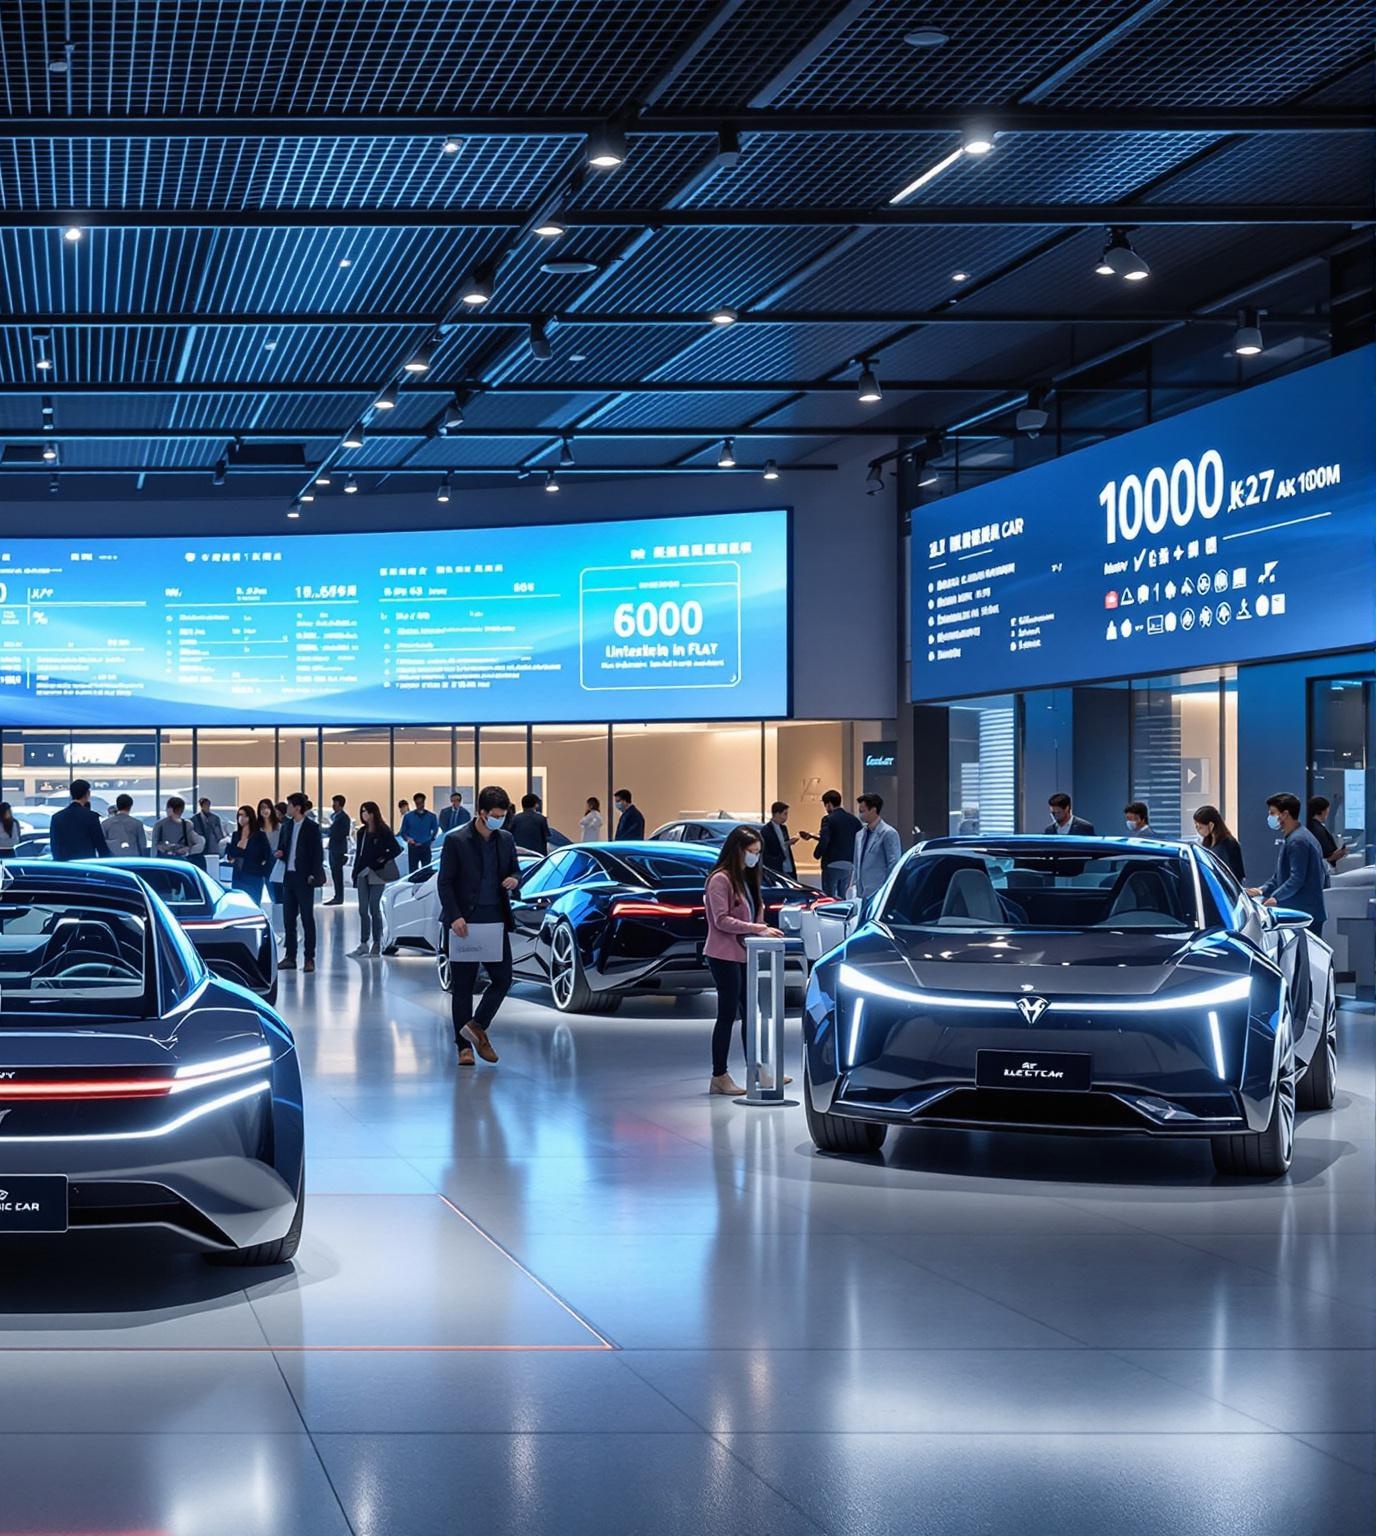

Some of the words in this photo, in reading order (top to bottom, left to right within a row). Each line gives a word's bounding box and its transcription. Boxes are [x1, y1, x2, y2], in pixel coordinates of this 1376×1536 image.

[1099, 449, 1224, 544] 10000
[613, 600, 704, 638] 6000
[15, 1202, 40, 1212] CAR
